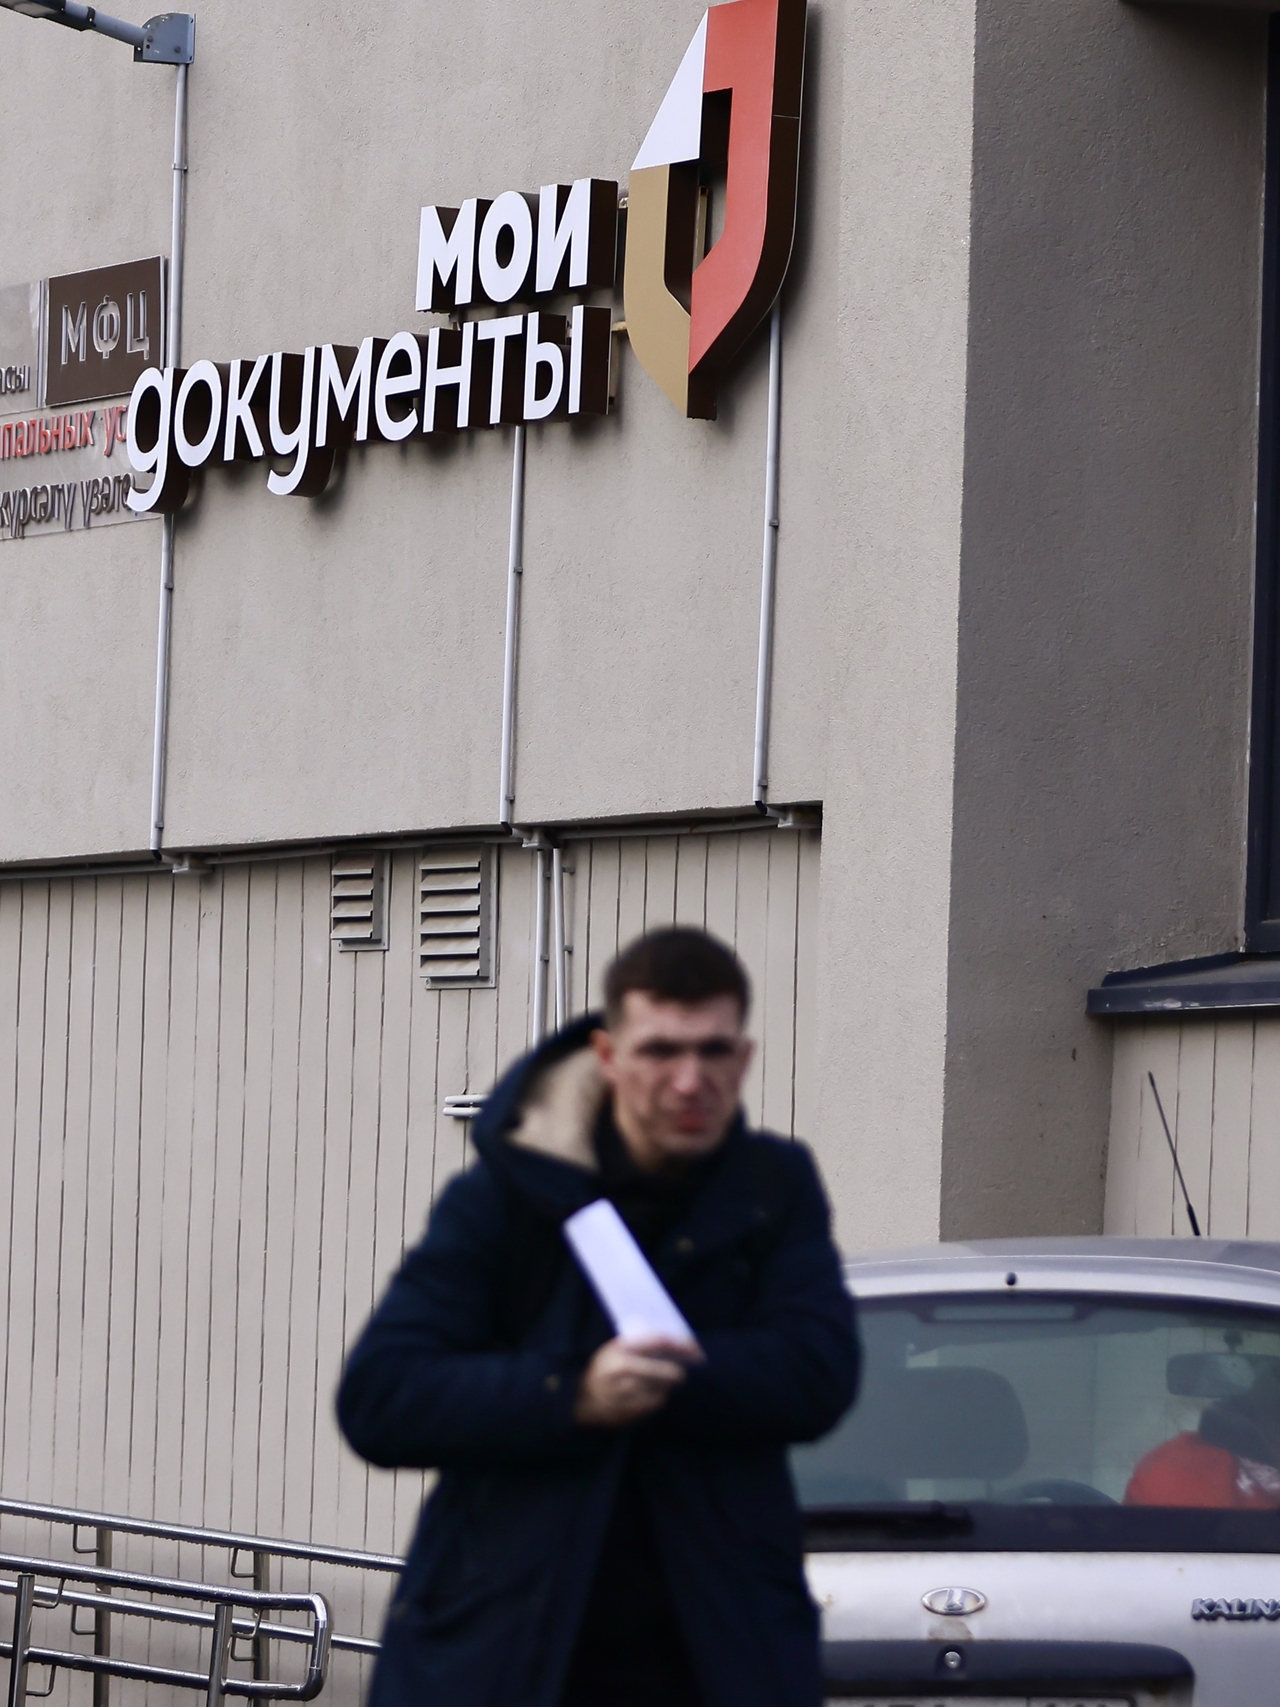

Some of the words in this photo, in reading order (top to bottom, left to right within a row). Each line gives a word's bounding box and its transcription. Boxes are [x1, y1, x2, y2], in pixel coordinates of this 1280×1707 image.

[415, 178, 592, 312] мои
[61, 289, 150, 365] МФЦ
[125, 304, 584, 512] документы
[1191, 1597, 1280, 1620] KALIN
